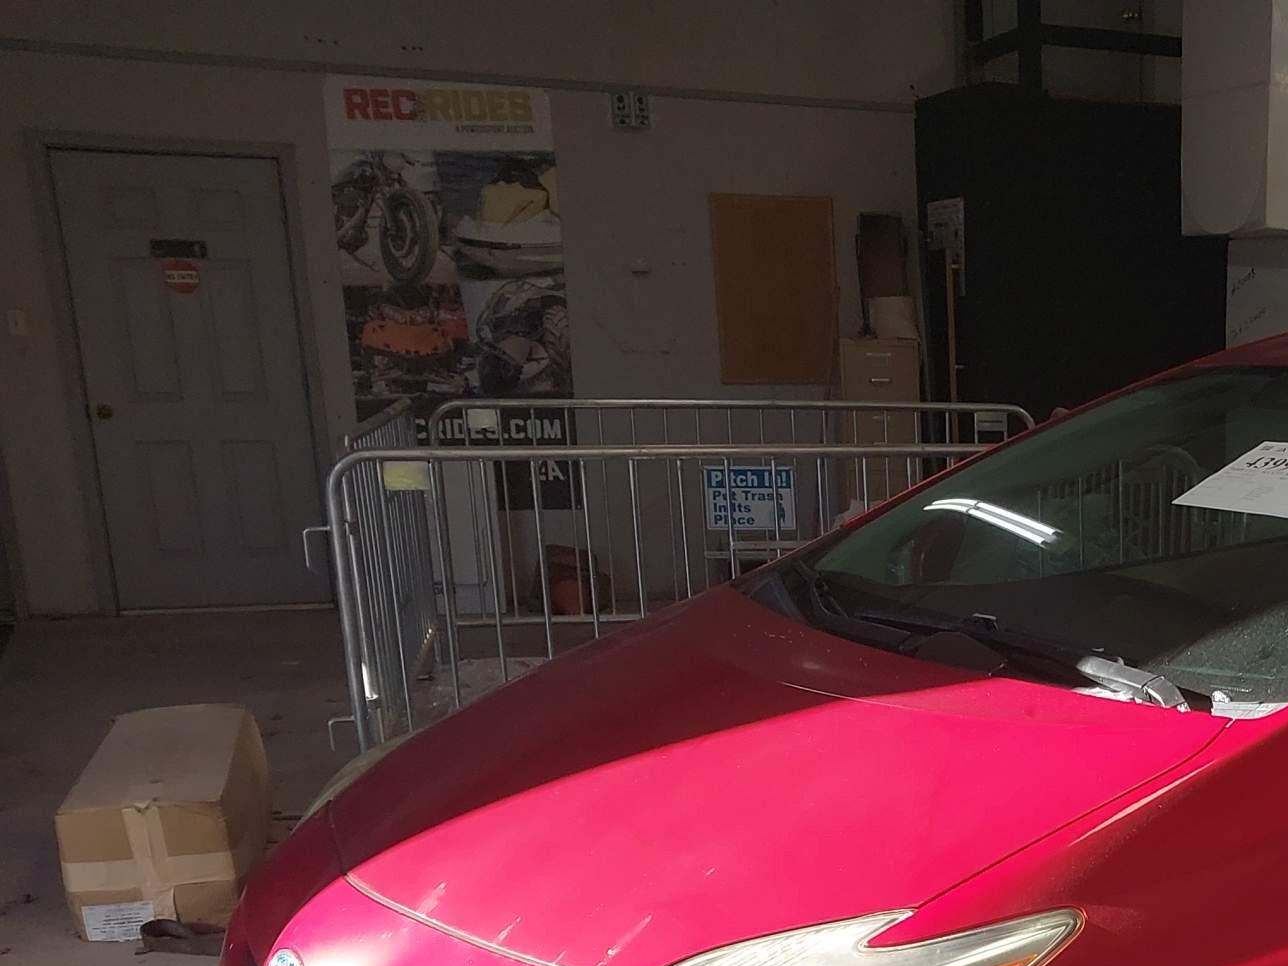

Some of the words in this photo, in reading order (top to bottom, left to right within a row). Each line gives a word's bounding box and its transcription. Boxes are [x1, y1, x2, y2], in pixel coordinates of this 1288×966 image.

[343, 88, 418, 121] REC
[430, 89, 533, 122] RIDES
[710, 471, 758, 487] Ptch
